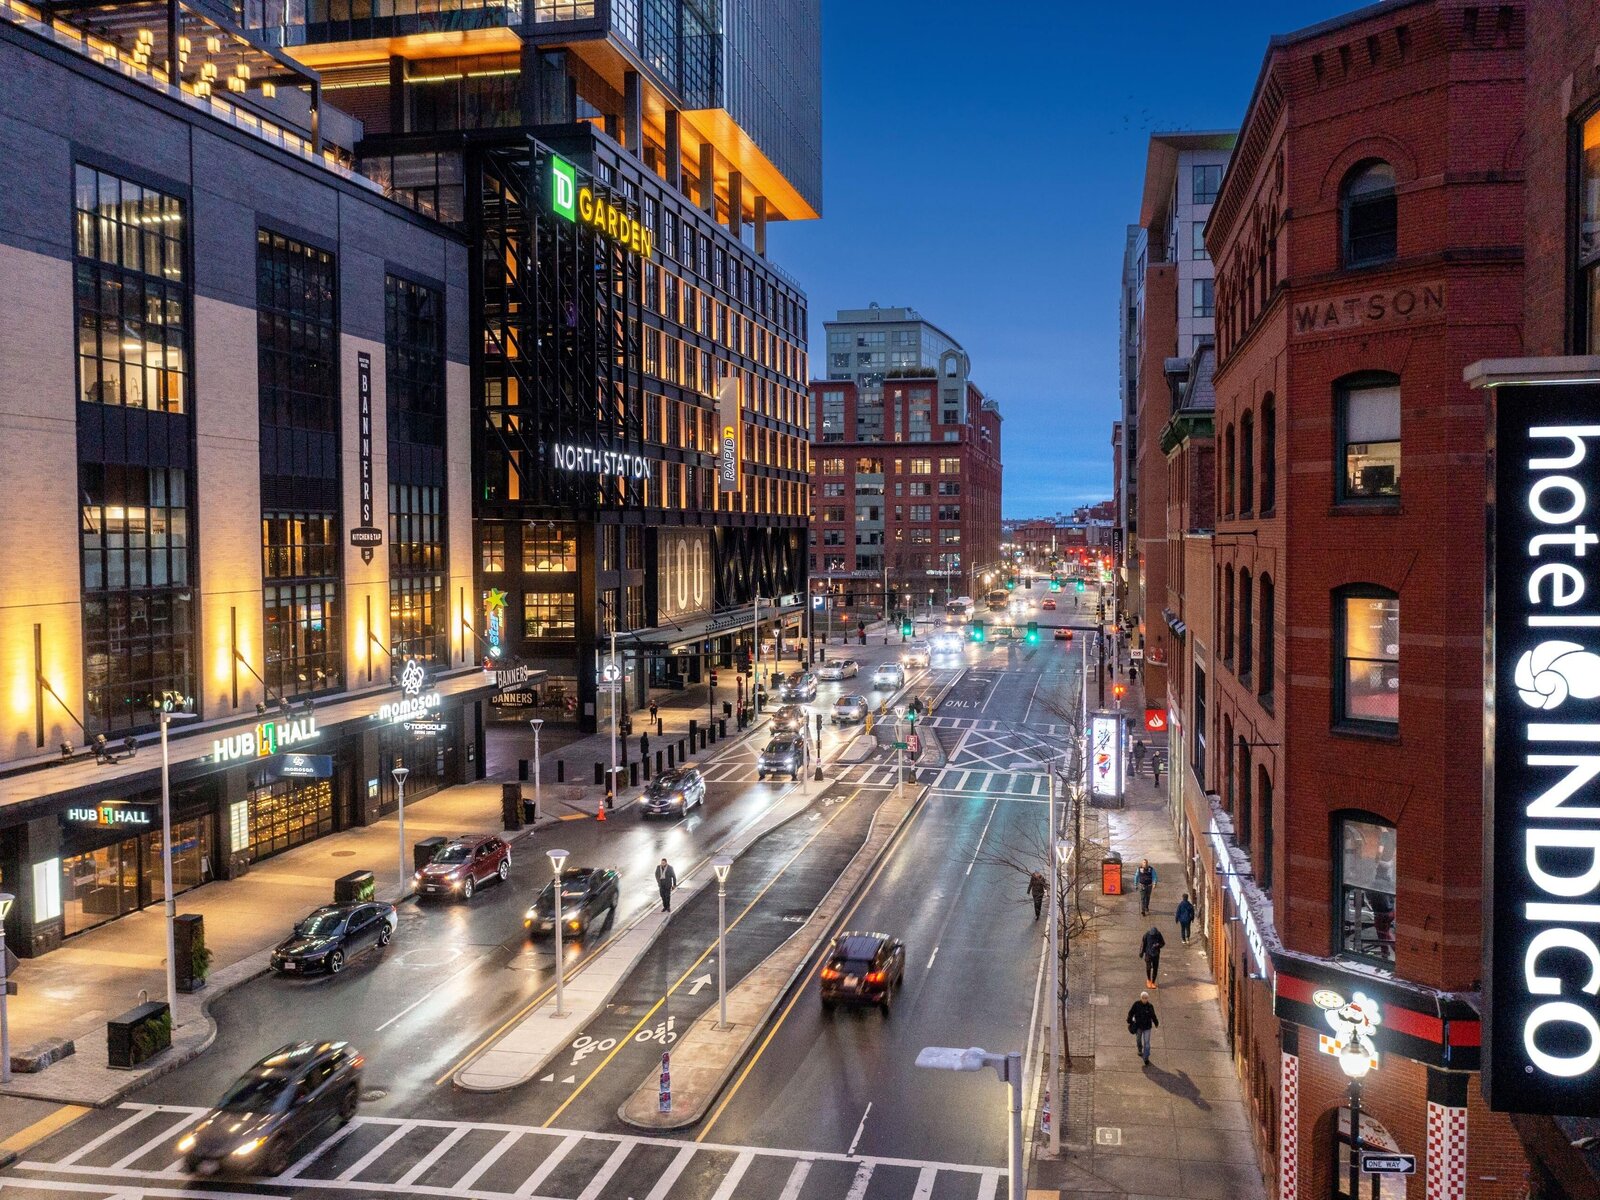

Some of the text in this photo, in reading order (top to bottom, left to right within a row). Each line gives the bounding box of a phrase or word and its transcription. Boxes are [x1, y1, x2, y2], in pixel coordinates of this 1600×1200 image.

[579, 187, 652, 258] GARDEN
[1296, 284, 1444, 331] WATSON
[361, 374, 371, 522] BANNERS
[555, 443, 651, 479] NORTH STATION
[723, 425, 735, 481] RAPID7
[666, 538, 704, 610] 100
[813, 597, 823, 609] P
[497, 664, 528, 689] BANNERS
[379, 693, 441, 721] momosan
[492, 692, 533, 704] BANNERS
[945, 700, 980, 708] ONLY
[213, 717, 321, 763] HUB HALL
[411, 723, 447, 731] TOPGOLF
[1524, 425, 1600, 1077] hotel INDIGO
[69, 808, 150, 824] HUB HALL
